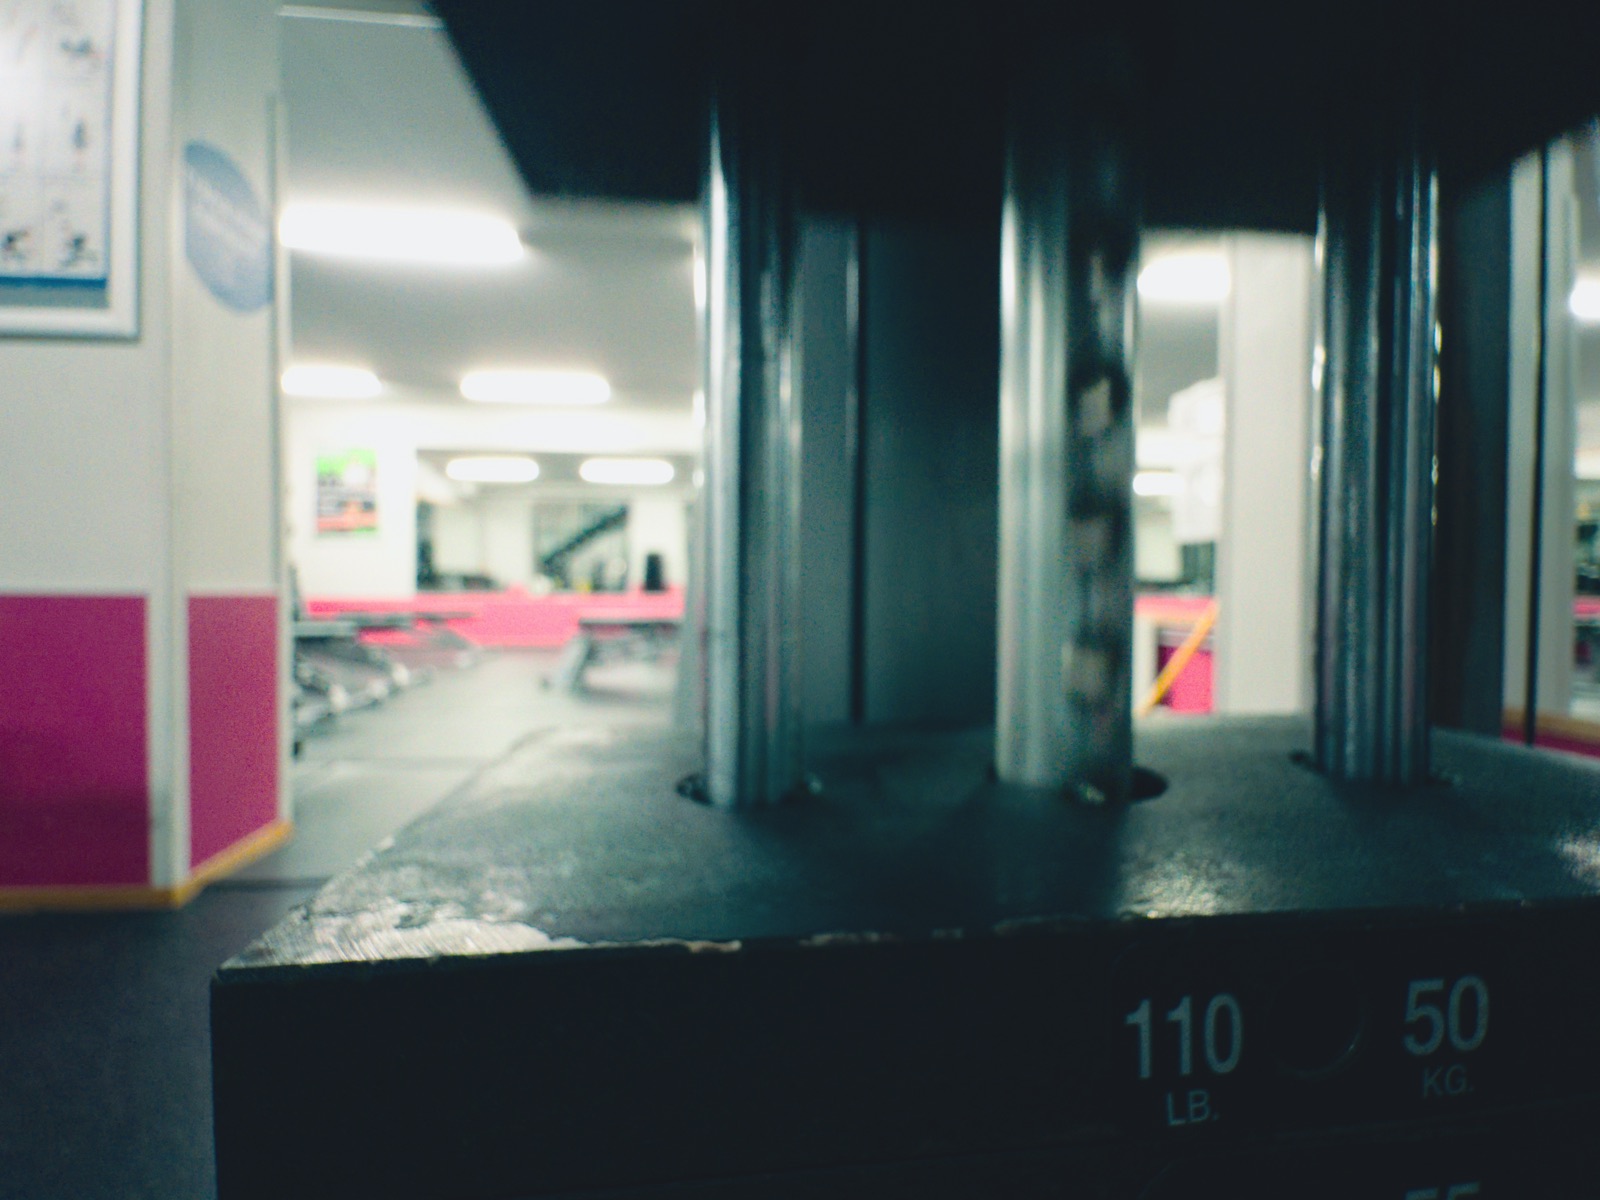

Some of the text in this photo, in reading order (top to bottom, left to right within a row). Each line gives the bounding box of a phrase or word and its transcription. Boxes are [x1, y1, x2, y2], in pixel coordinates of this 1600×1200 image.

[1125, 993, 1243, 1079] 110
[1402, 975, 1490, 1057] 50
[1165, 1090, 1220, 1126] LB.
[1421, 1065, 1475, 1098] KG.
